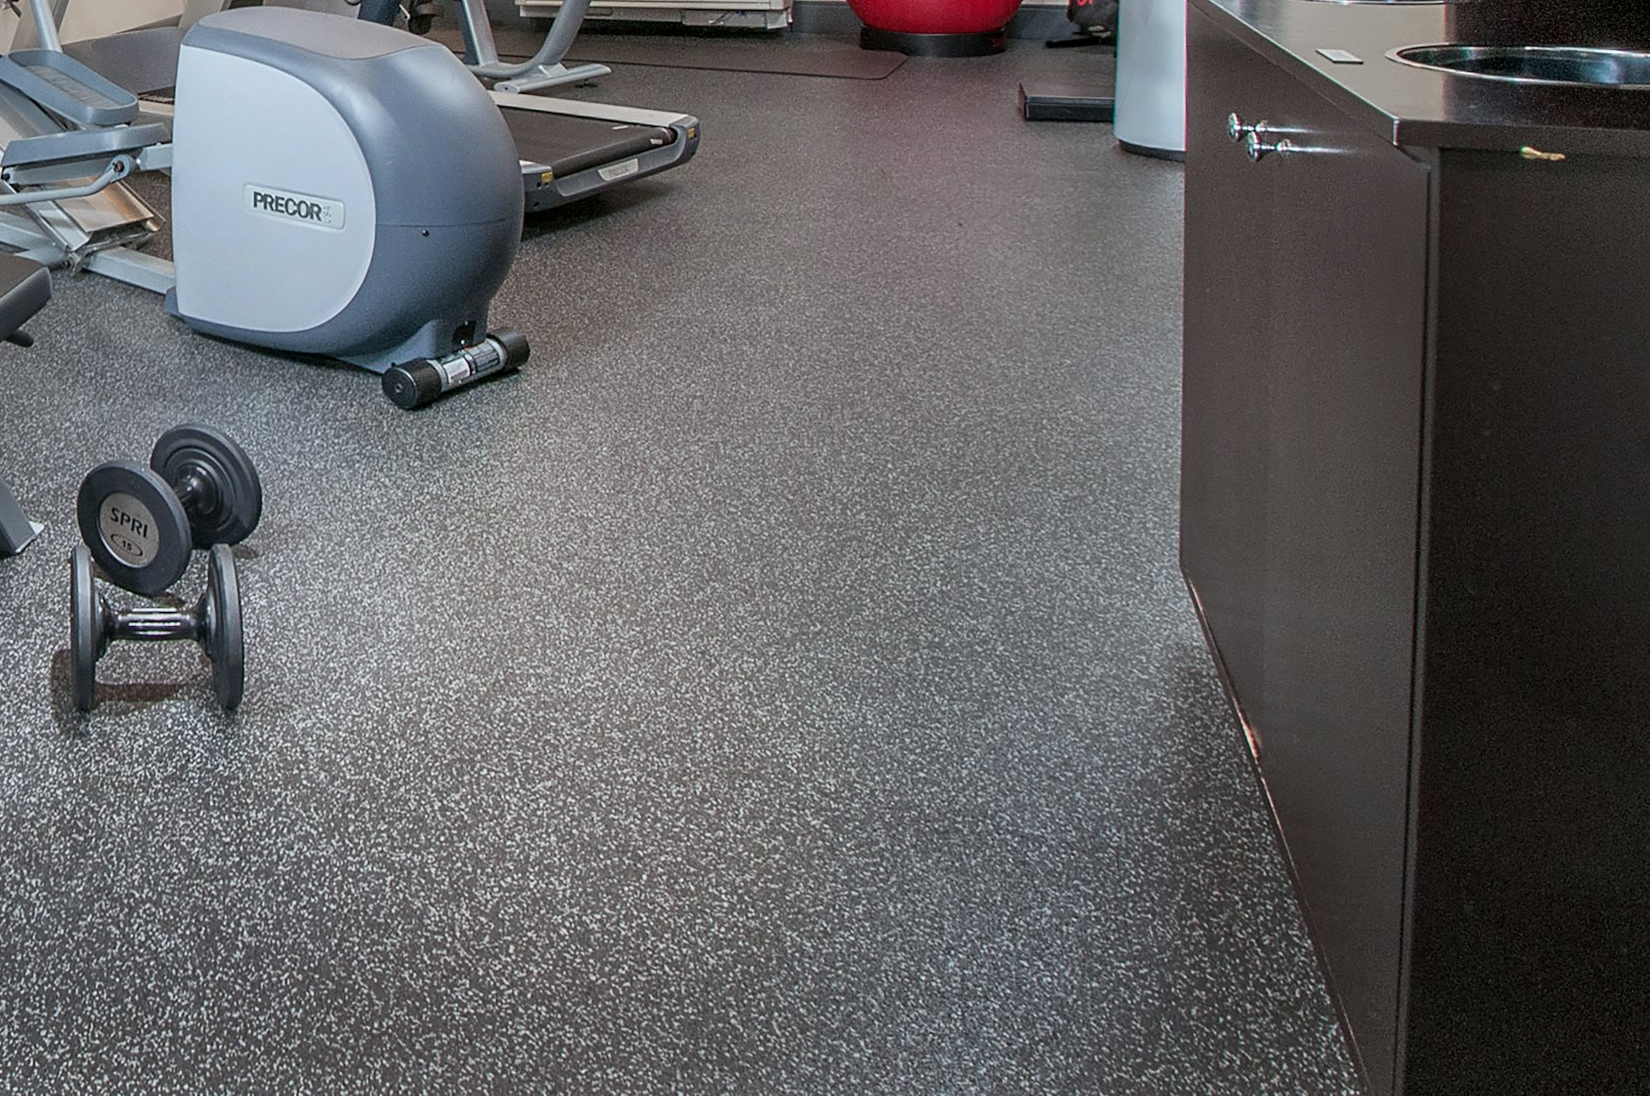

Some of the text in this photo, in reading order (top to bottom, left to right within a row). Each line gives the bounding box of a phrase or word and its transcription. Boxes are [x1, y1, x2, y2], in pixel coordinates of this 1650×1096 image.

[253, 191, 322, 222] PRECOR
[110, 507, 148, 538] SPRI
[122, 540, 132, 551] 15
